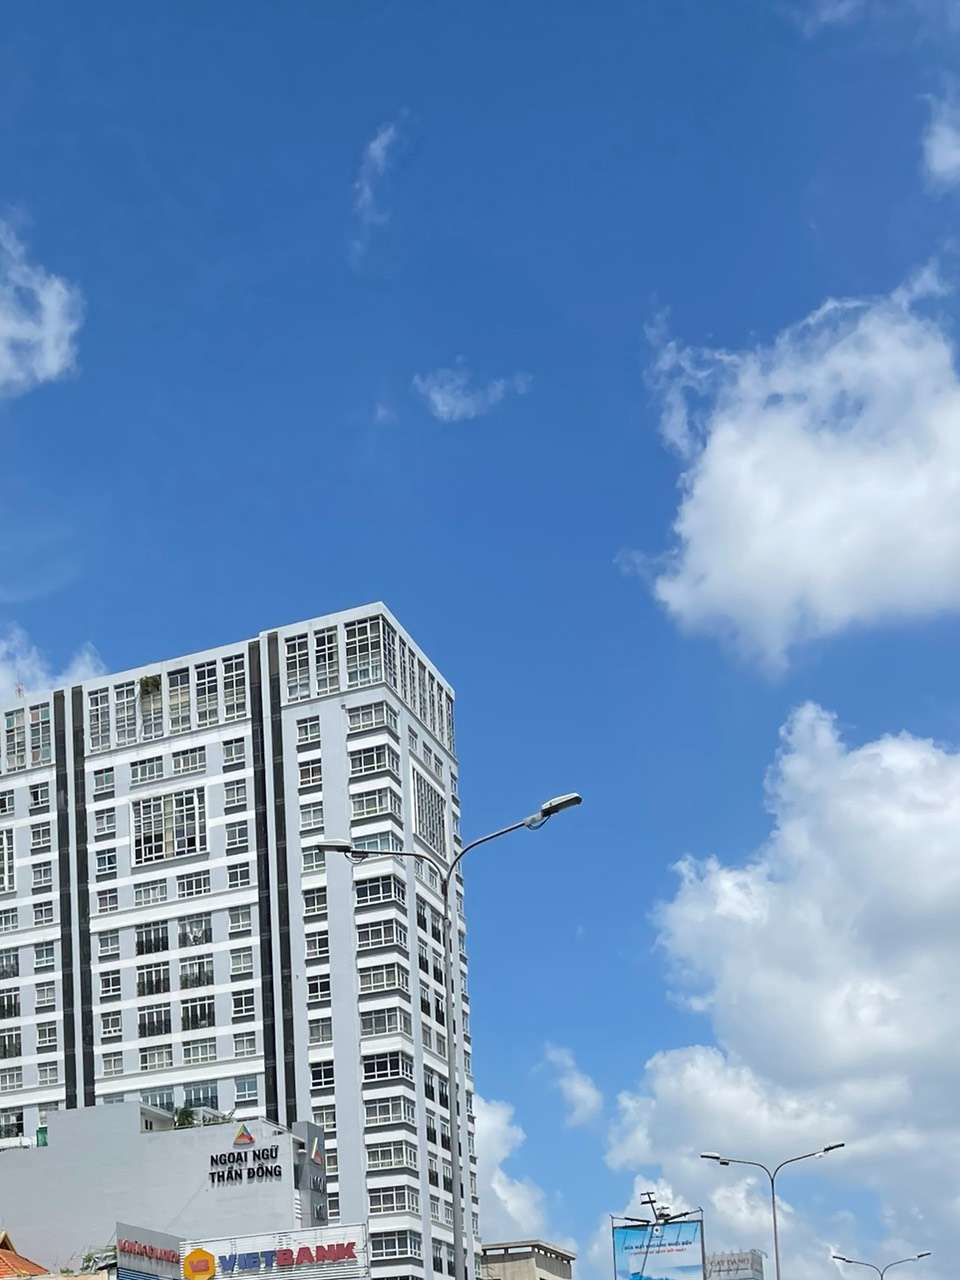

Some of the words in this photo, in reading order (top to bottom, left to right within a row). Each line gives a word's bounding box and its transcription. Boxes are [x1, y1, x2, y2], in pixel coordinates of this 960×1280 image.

[210, 1151, 248, 1166] NGOẠI
[252, 1144, 279, 1161] NGỮ
[247, 1162, 282, 1179] ĐỒNG
[218, 1241, 356, 1274] VIETBANK
